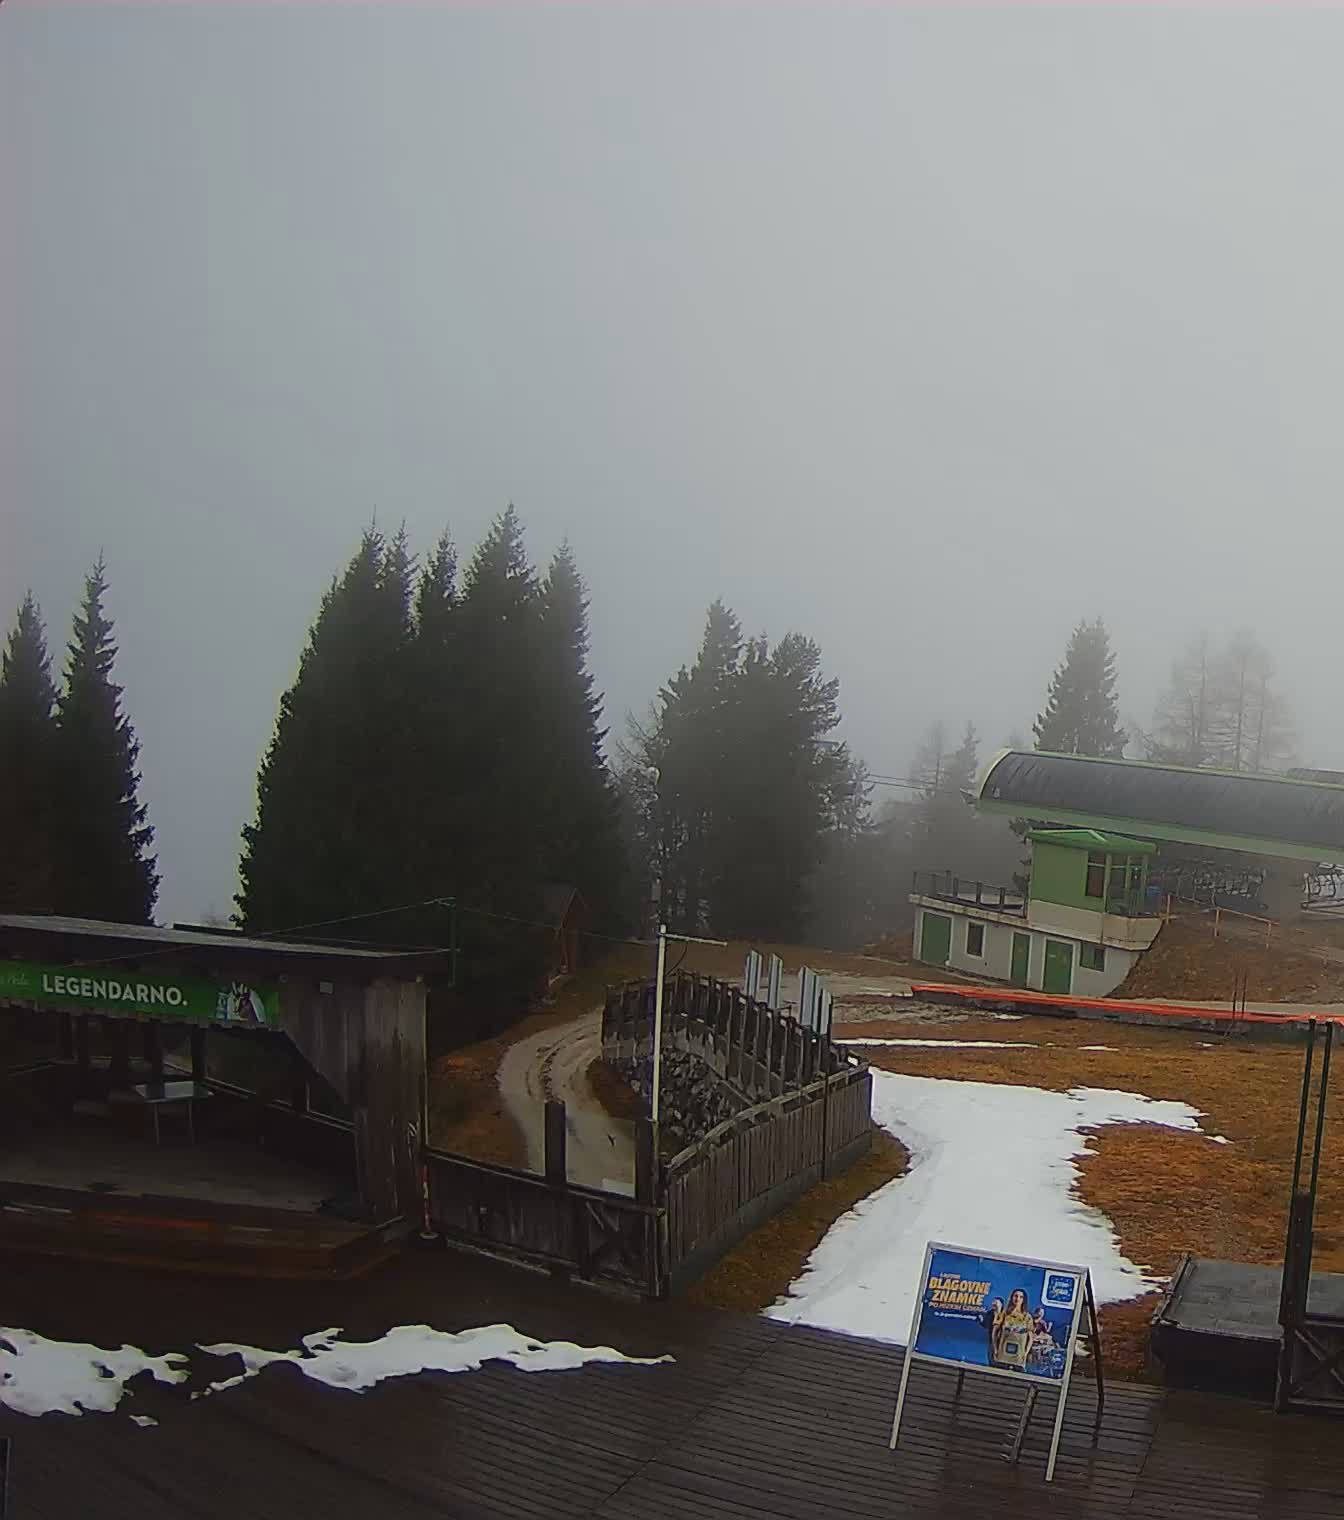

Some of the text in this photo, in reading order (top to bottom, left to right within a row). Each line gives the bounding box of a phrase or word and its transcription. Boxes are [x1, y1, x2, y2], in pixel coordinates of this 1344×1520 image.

[42, 973, 189, 1007] LEGENDARNO.
[929, 1277, 991, 1295] BLAGOVNE
[931, 1289, 985, 1306] ZNAMKE
